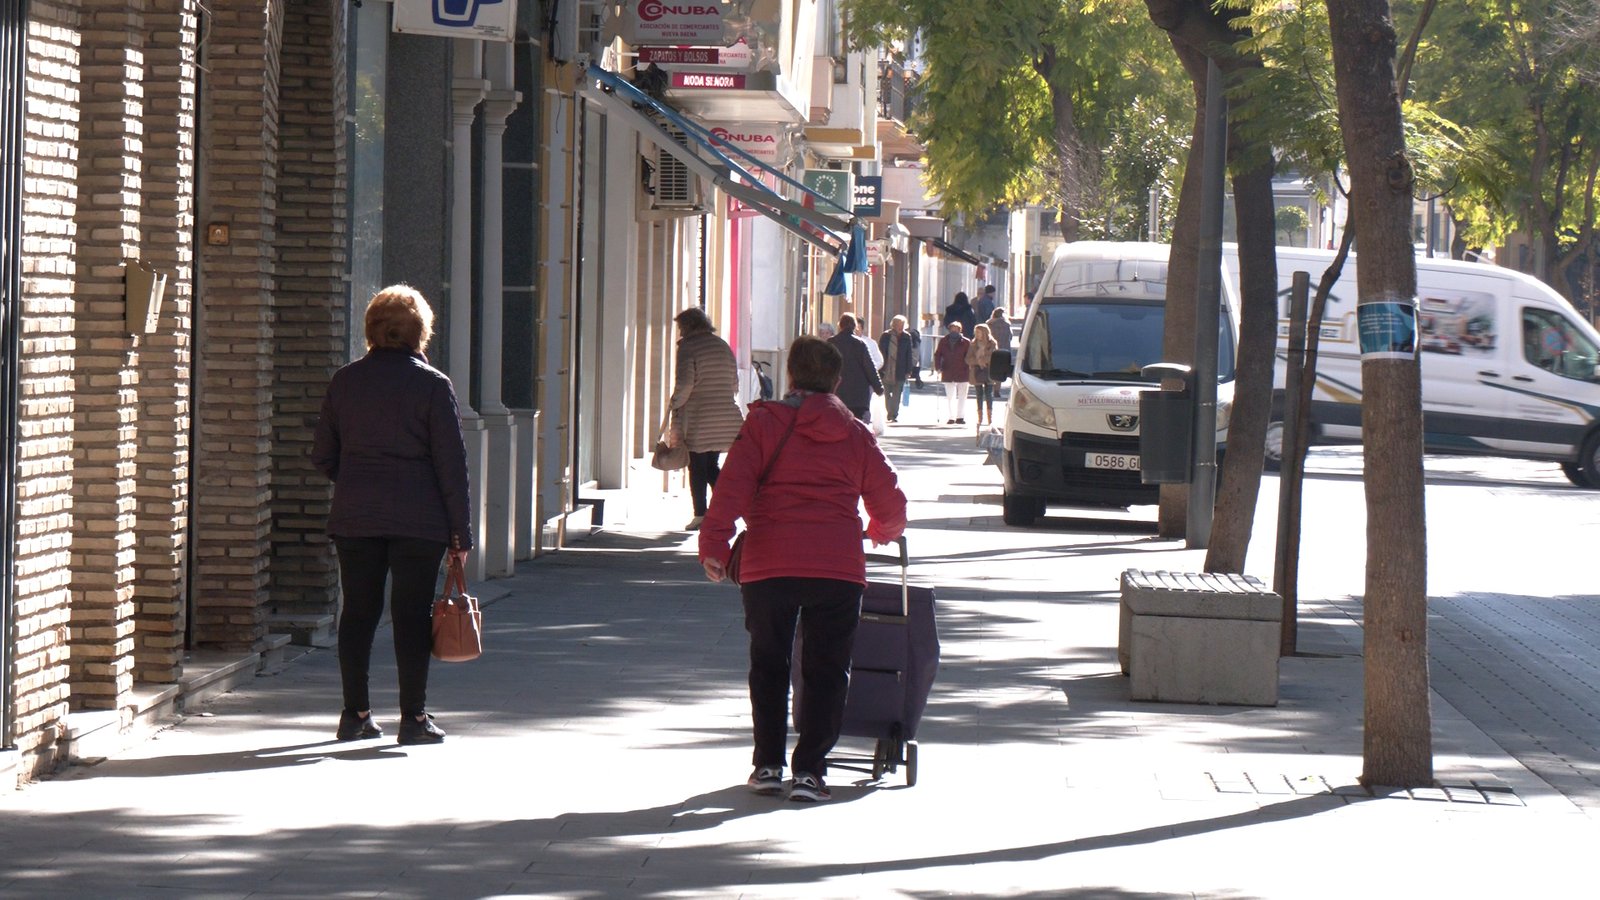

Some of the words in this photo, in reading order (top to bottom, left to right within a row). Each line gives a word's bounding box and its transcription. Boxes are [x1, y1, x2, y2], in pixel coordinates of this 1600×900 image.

[637, 0, 720, 22] CONUBA
[649, 50, 676, 61] ZAPATOS
[684, 51, 709, 62] BOLSOS
[683, 75, 704, 86] MODA
[1095, 455, 1124, 468] 0586
